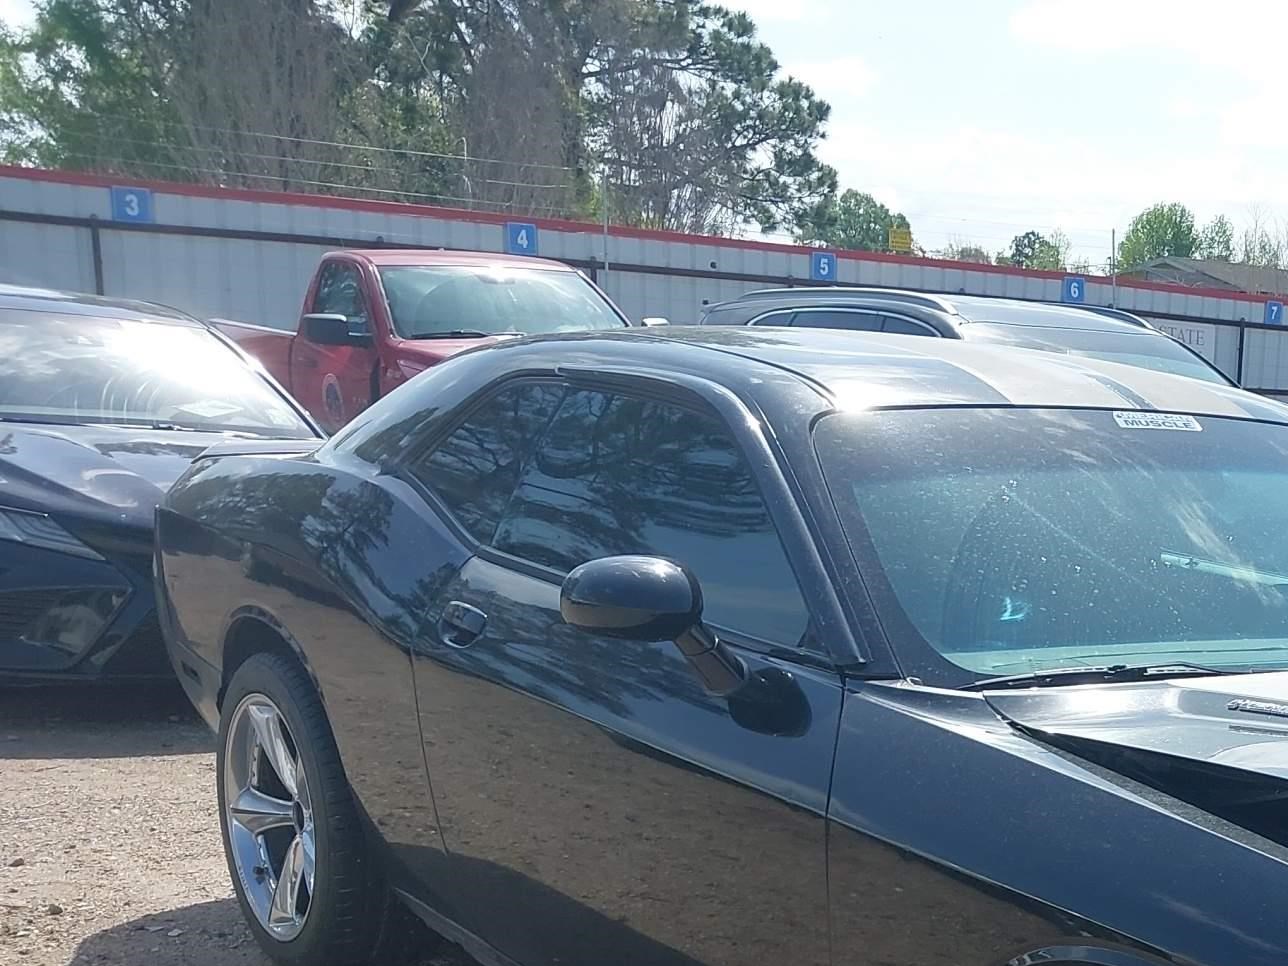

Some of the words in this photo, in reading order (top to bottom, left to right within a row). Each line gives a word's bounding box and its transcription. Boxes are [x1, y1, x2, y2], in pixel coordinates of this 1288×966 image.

[125, 194, 139, 216] 3
[517, 229, 529, 250] 4
[819, 258, 829, 276] 5
[1070, 282, 1079, 298] 6
[1270, 305, 1278, 320] 7
[1123, 419, 1193, 429] MUSCLE
